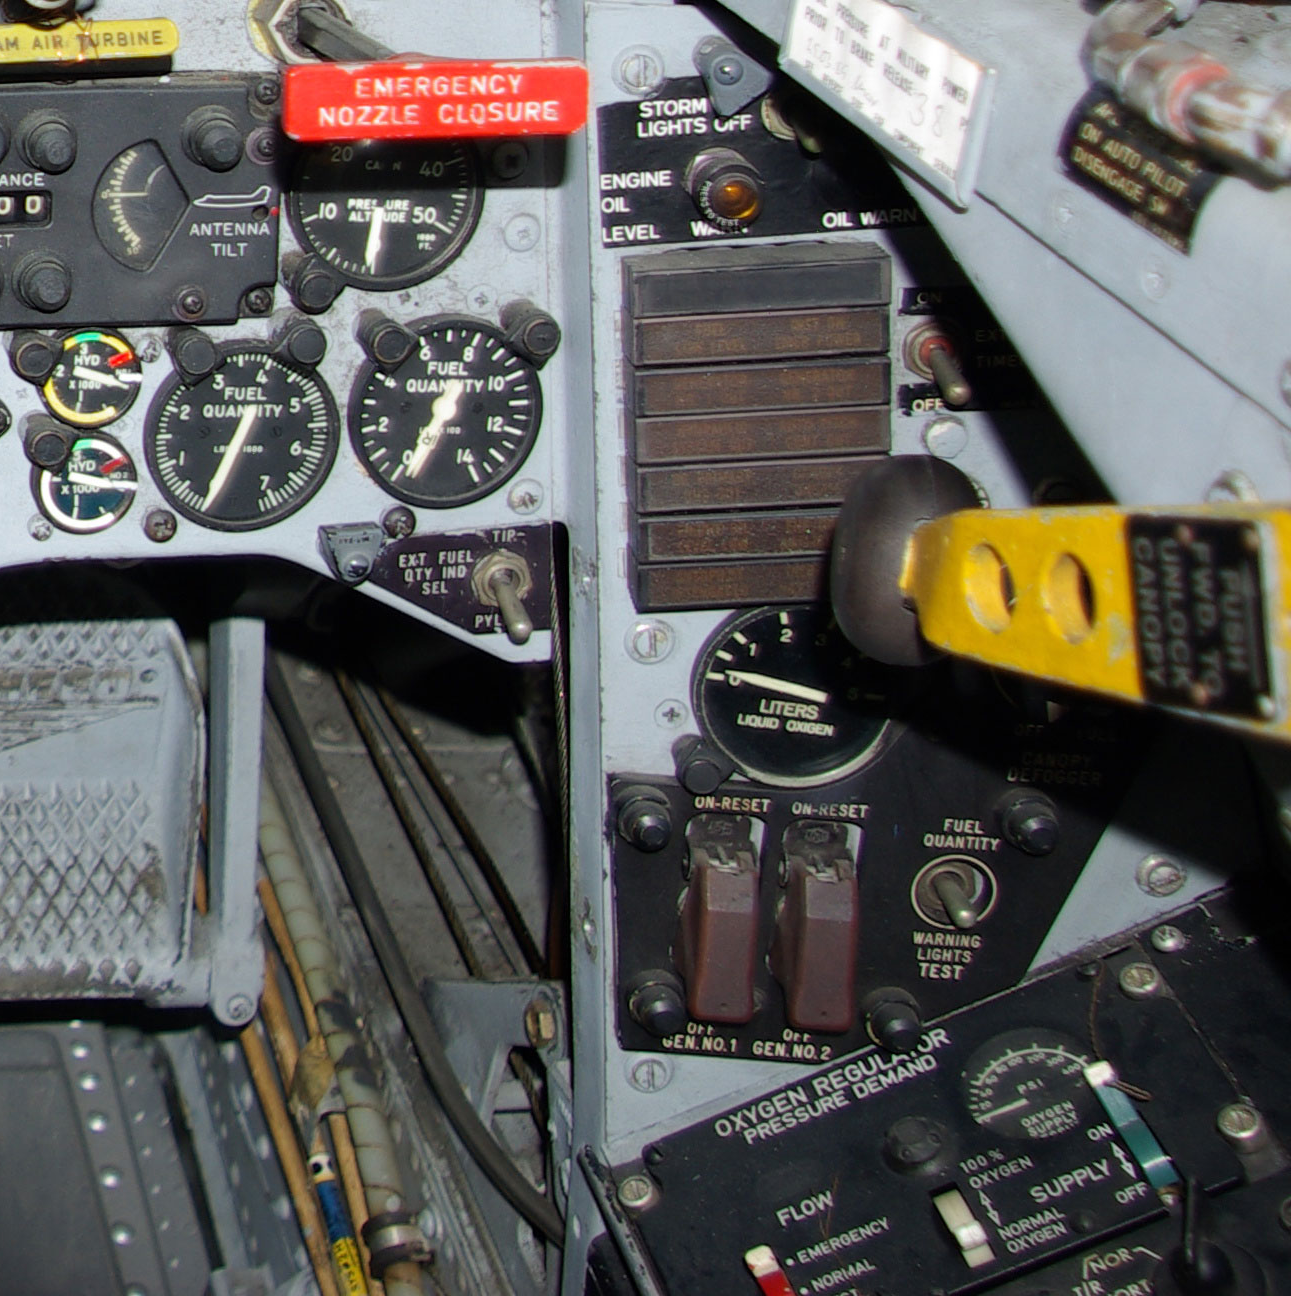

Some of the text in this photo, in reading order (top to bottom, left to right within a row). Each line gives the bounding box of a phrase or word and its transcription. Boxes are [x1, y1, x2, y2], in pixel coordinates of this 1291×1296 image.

[850, 40, 875, 67] BRAKE
[355, 74, 523, 99] EMERGENCY
[318, 101, 560, 127] NOZZLE CLOSURE
[639, 98, 707, 118] STORM
[600, 170, 673, 190] ENGINE
[1072, 146, 1145, 203] DISENGAGE
[601, 197, 631, 213] OIL
[822, 208, 917, 228] OIL WARN
[189, 222, 270, 236] ANTENNA
[602, 225, 661, 242] LEVEL
[211, 243, 247, 257] TILT
[74, 353, 100, 367] HYD
[427, 362, 468, 376] FUEL
[224, 386, 267, 401] FUEL
[68, 460, 96, 472] HYD
[398, 550, 474, 568] EXT FUEL
[404, 564, 467, 582] QTY IND
[422, 581, 448, 595] SEL
[1135, 538, 1165, 685] CANOPY
[1160, 538, 1193, 687] UNLOCK
[759, 699, 820, 720] LITERS
[737, 713, 834, 737] LIQUID OXIGEN
[944, 819, 984, 835] FUEL
[923, 833, 1001, 851] QUANTITY
[913, 931, 981, 948] WARNING
[918, 947, 972, 964] LIGHTS
[918, 964, 965, 980] TEST
[743, 1054, 937, 1145] PRESSURE DEMAND
[714, 1086, 809, 1138] OXYGEN
[1086, 1123, 1113, 1142] ON
[969, 1155, 1035, 1190] OXYGEN
[1030, 1159, 1110, 1204] SUPPLY
[1115, 1182, 1148, 1204] OFF
[776, 1190, 834, 1228] FLOW
[997, 1207, 1066, 1241] NORMAL
[796, 1216, 891, 1265] EMERGENCY
